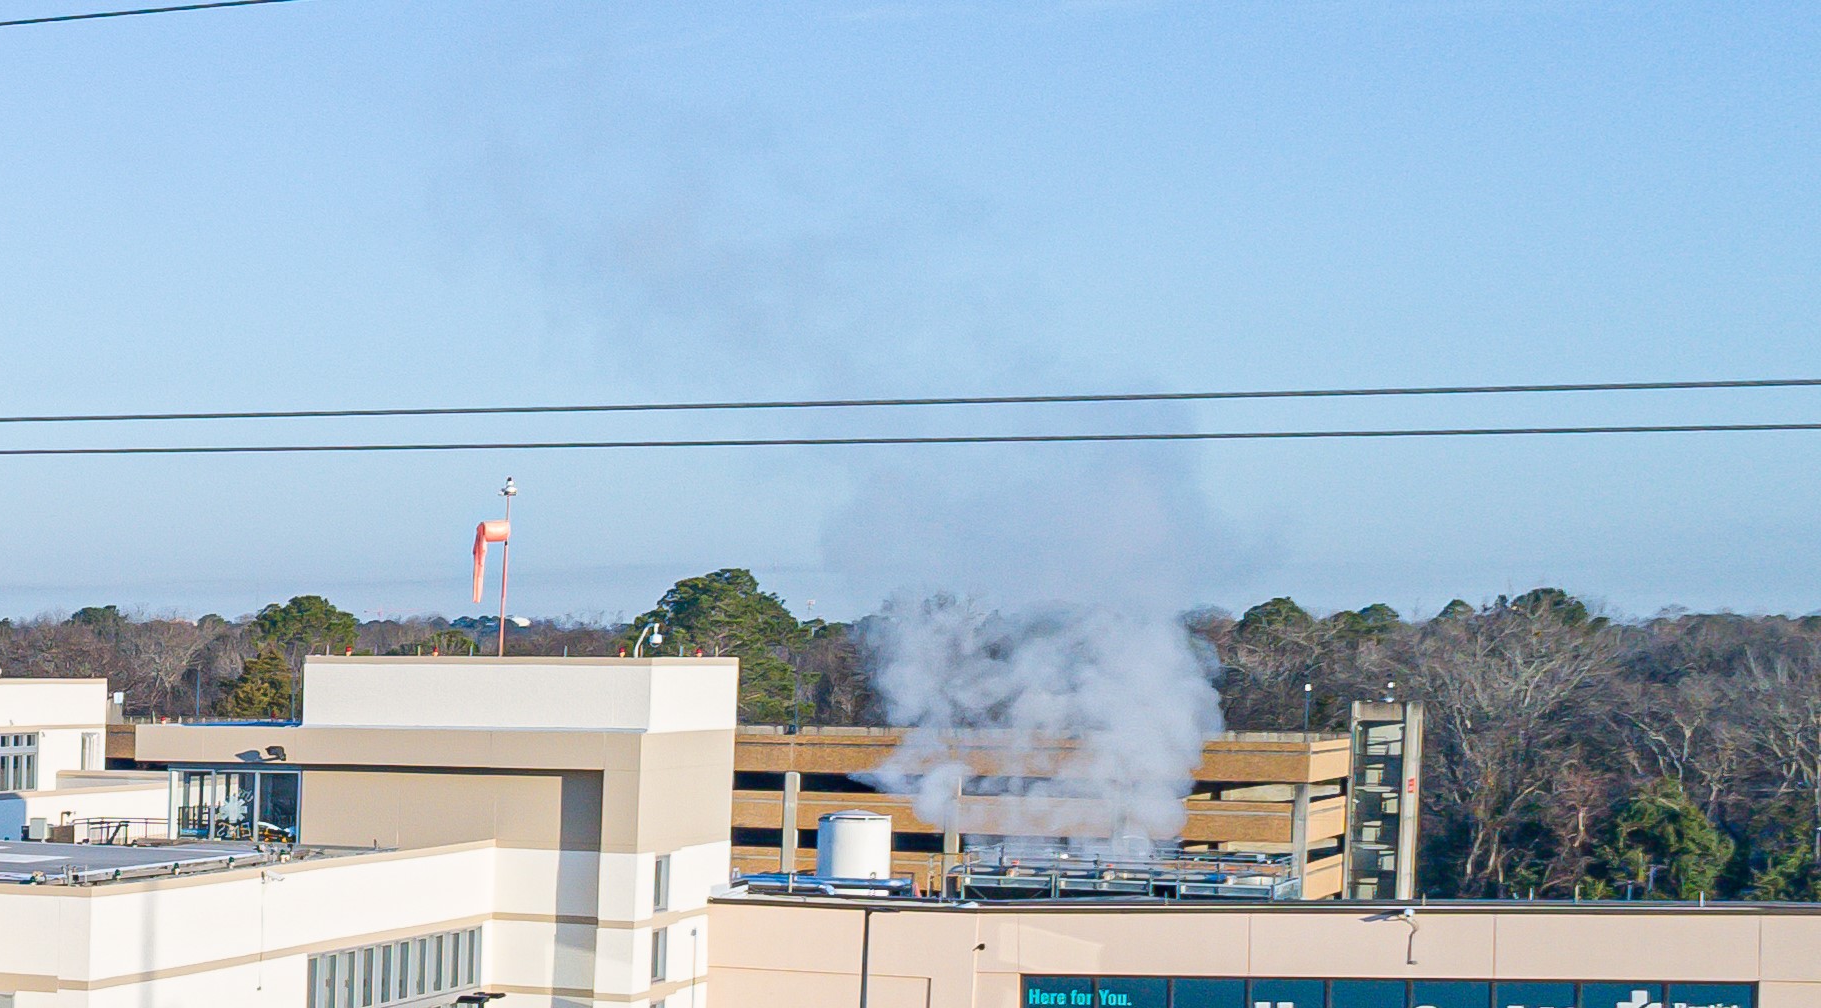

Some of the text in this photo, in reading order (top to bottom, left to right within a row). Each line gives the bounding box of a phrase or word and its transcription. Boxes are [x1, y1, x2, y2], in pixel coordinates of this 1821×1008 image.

[1028, 988, 1132, 1006] Here for You.
